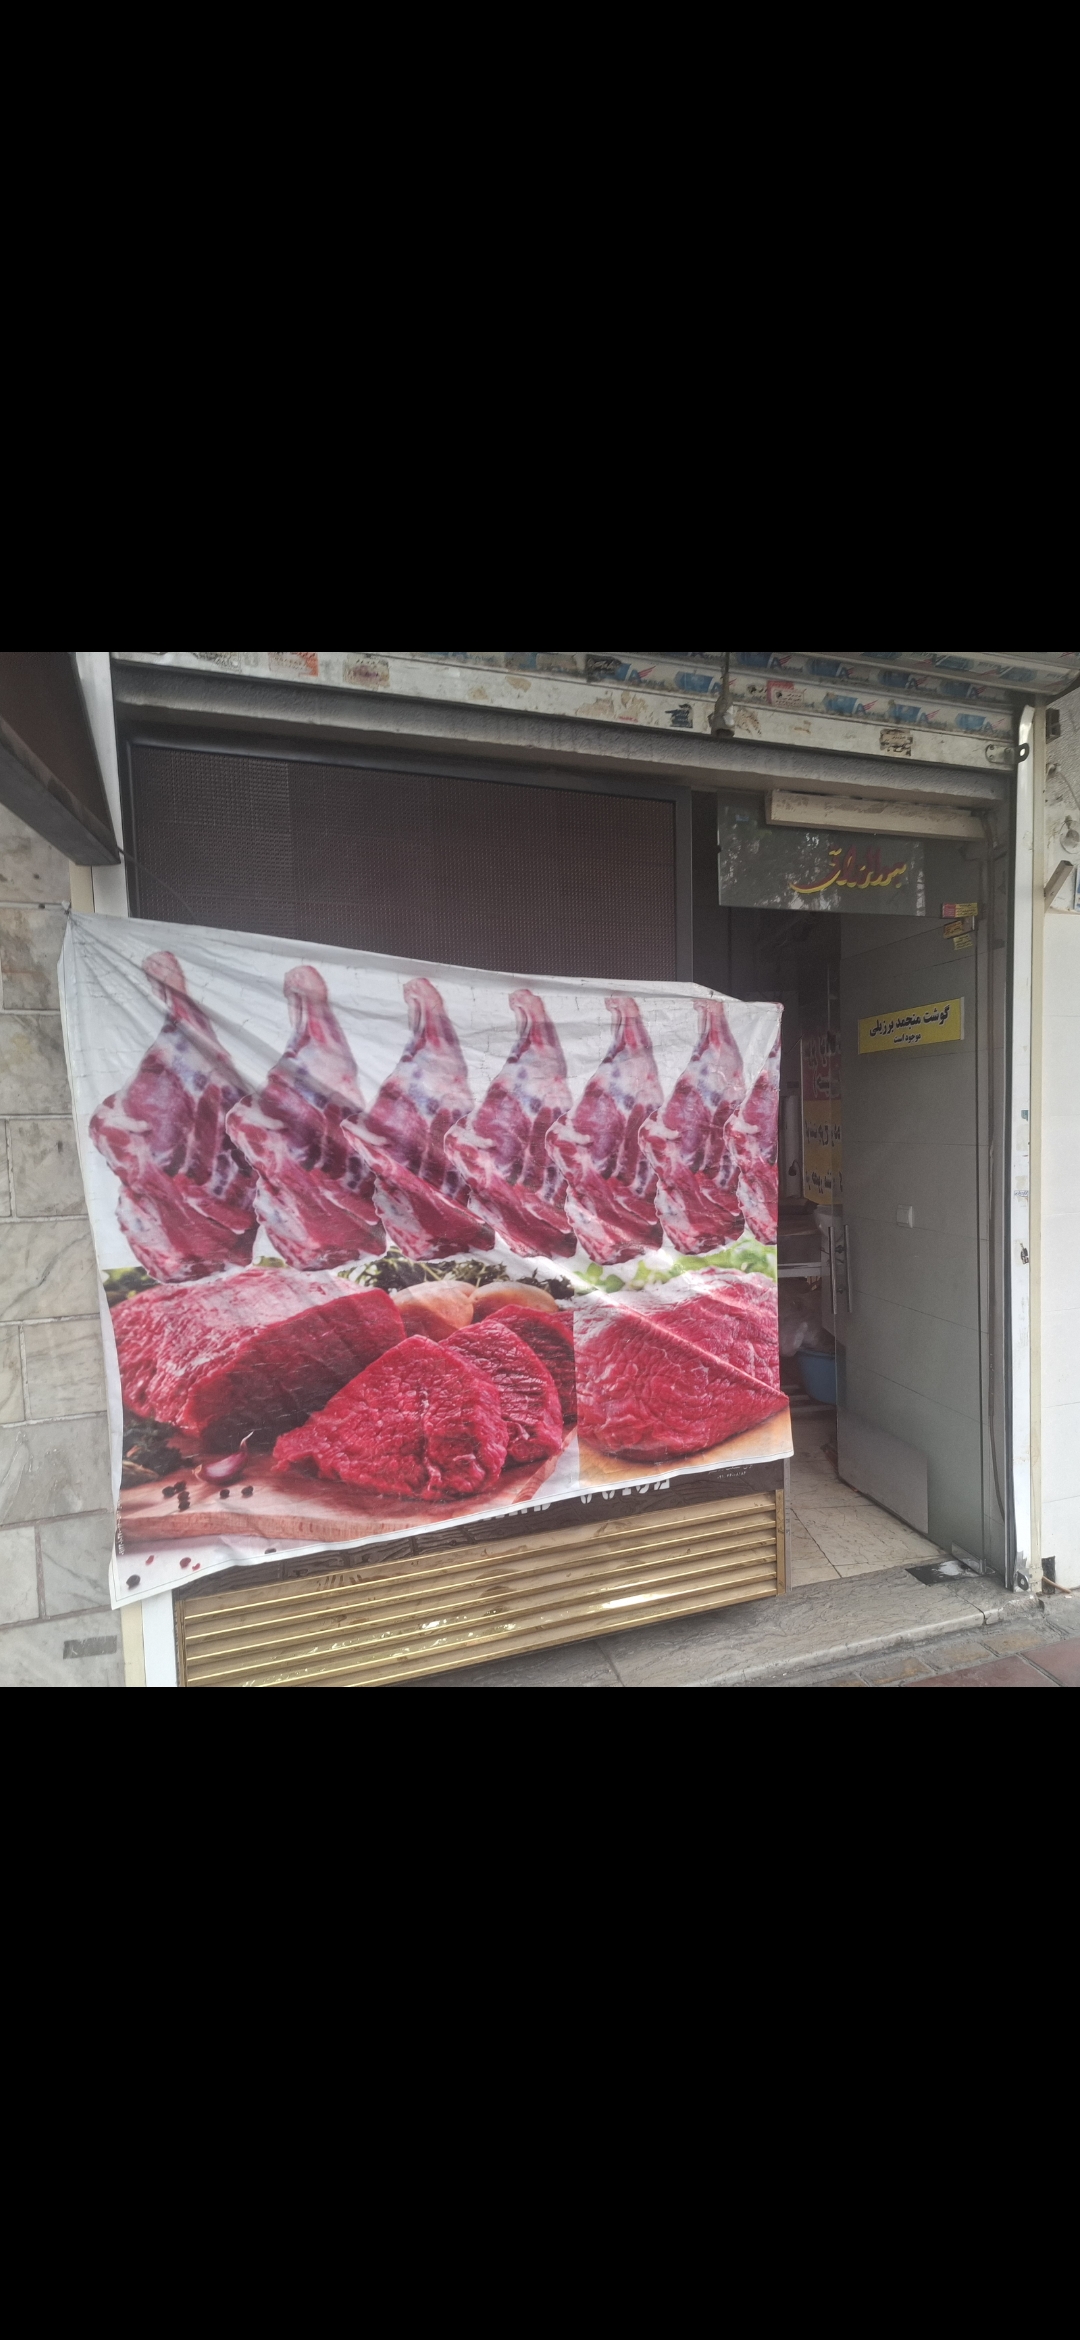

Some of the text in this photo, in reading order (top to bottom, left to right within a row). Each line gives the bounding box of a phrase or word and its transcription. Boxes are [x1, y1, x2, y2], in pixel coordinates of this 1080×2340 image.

[869, 1004, 950, 1037] گوشت منجمد برزیلی
[893, 1033, 921, 1044] موجود است
